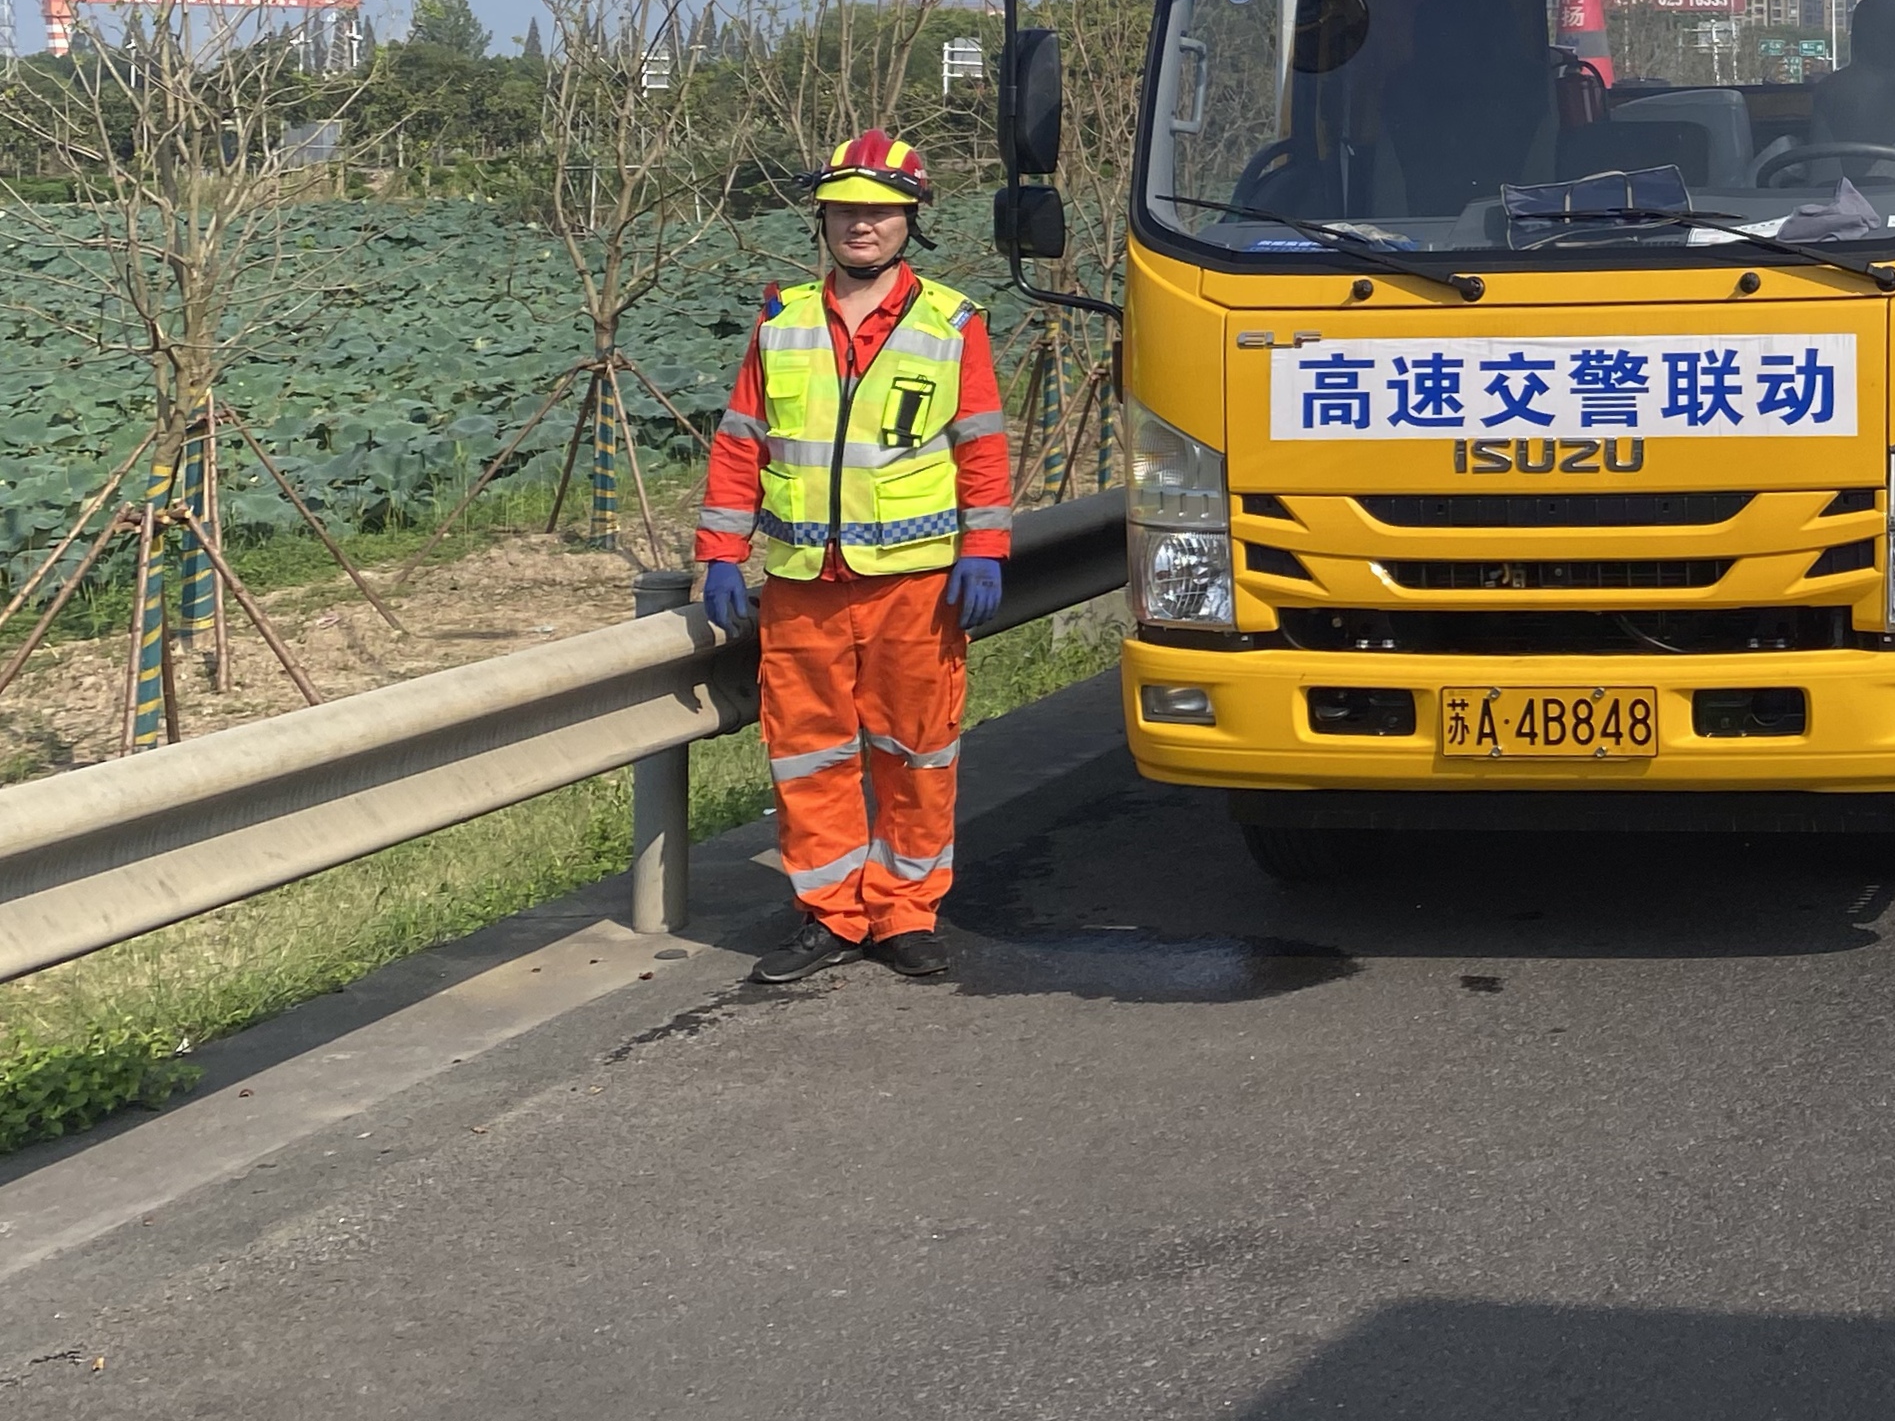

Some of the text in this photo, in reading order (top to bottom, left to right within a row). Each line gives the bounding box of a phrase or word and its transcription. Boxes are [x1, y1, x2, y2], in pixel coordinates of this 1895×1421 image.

[1236, 330, 1322, 349] ELF
[1298, 347, 1835, 429] 高速交警联动
[1454, 437, 1645, 474] ISUZU
